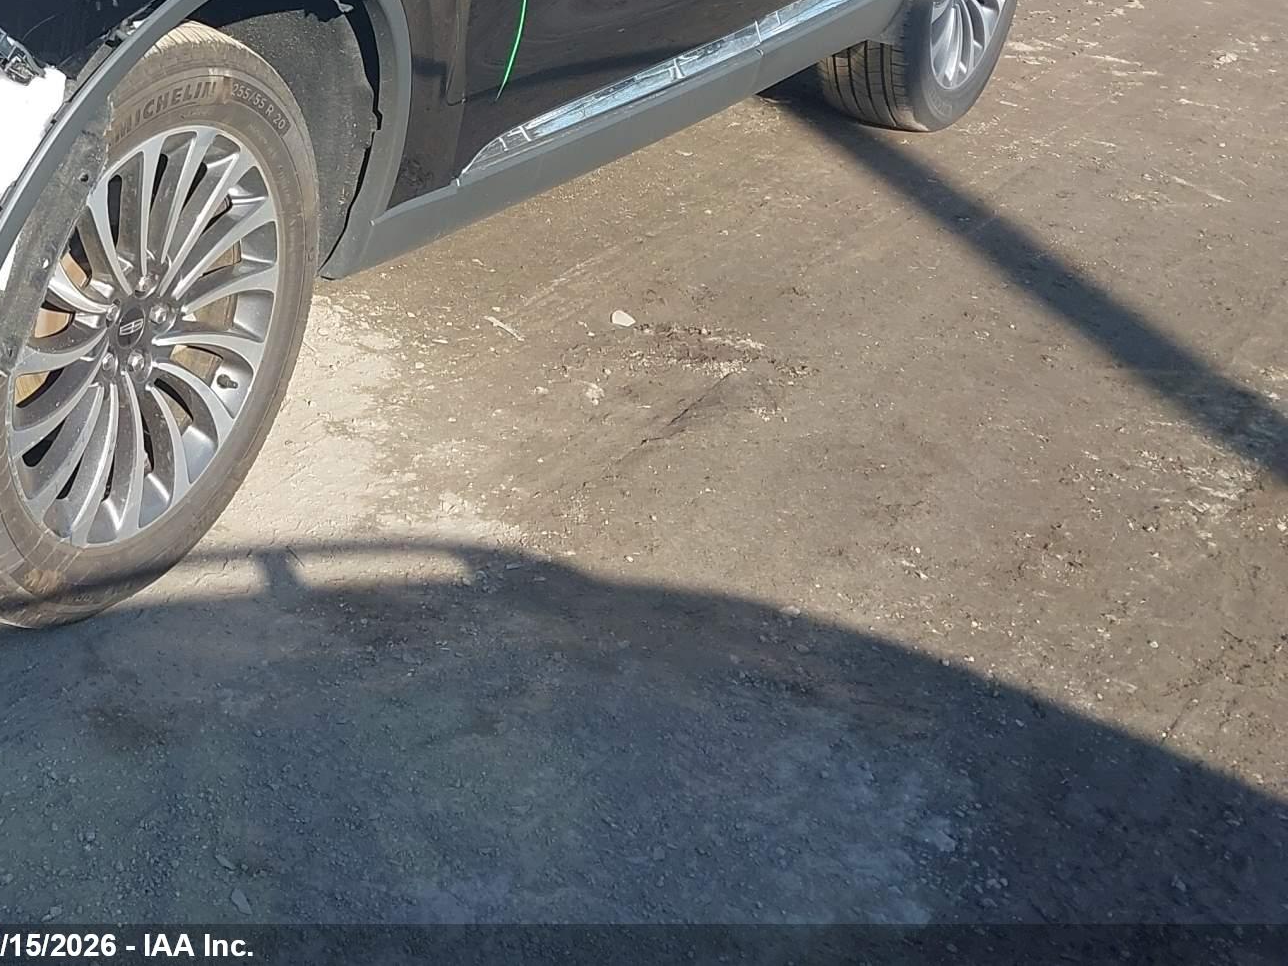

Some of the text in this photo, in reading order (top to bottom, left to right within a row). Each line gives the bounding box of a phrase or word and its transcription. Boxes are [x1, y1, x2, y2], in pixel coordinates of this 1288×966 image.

[114, 81, 217, 143] MICHELIN
[231, 83, 286, 130] 255/55 R 20
